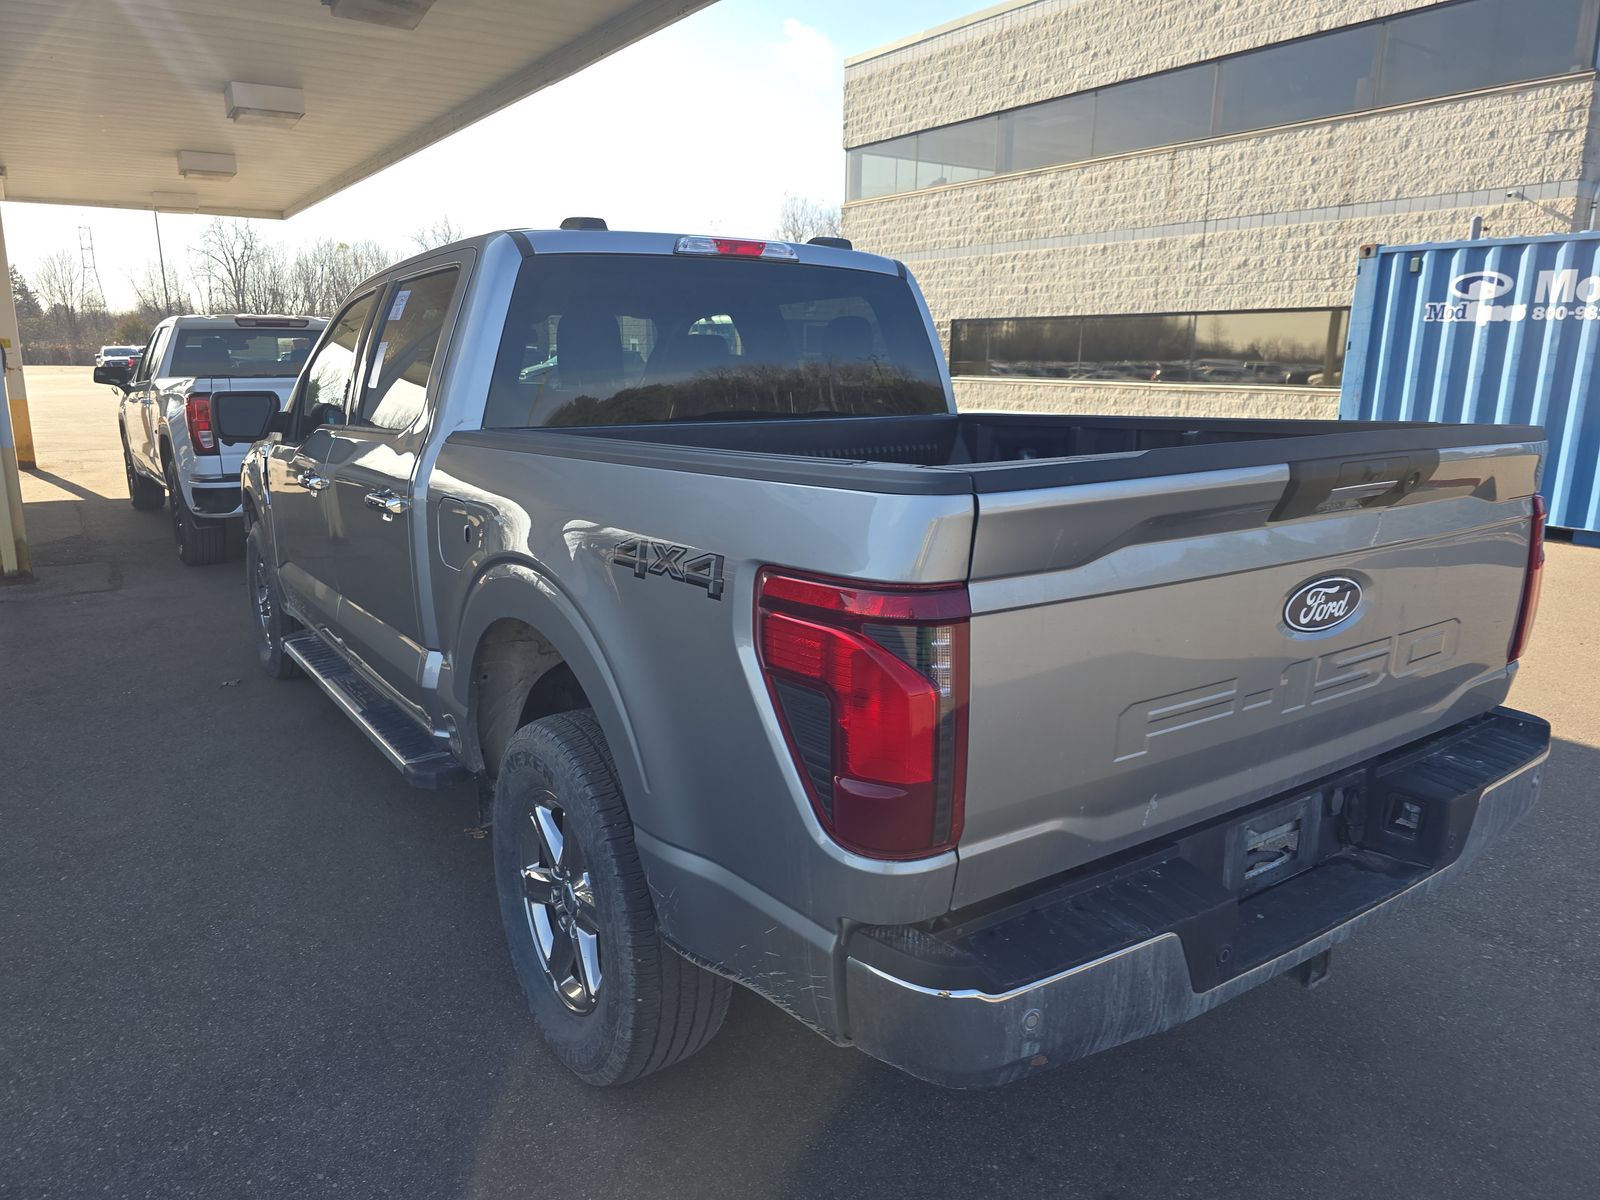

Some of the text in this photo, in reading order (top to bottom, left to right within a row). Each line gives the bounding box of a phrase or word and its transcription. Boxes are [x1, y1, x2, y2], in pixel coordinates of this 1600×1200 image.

[1532, 305, 1600, 320] 800-98
[1299, 585, 1351, 625] Ford
[1112, 616, 1462, 763] F-150
